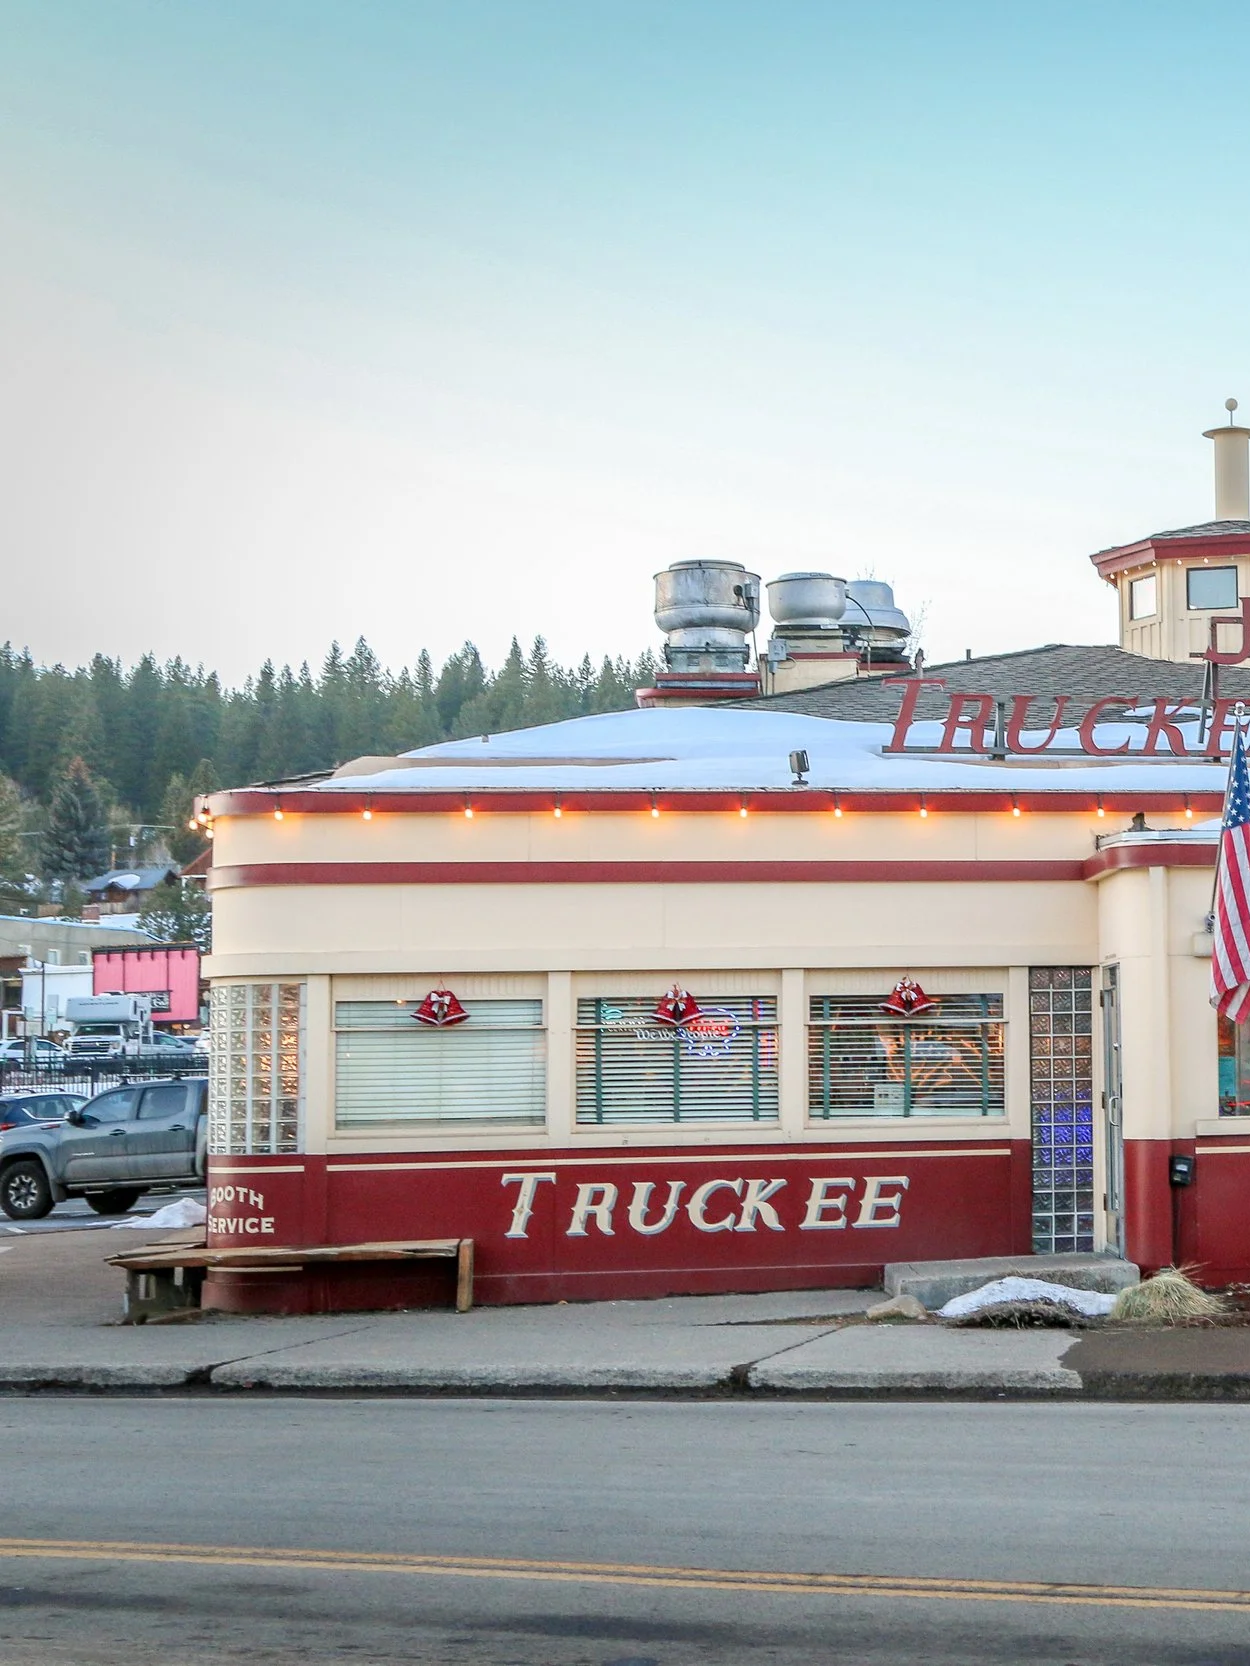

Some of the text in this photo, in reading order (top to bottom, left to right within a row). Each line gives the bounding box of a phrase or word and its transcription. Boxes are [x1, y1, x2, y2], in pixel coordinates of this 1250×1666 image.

[210, 1185, 265, 1211] BOOTH
[501, 1172, 909, 1238] TRUCKEE
[208, 1214, 275, 1234] SERVICE
